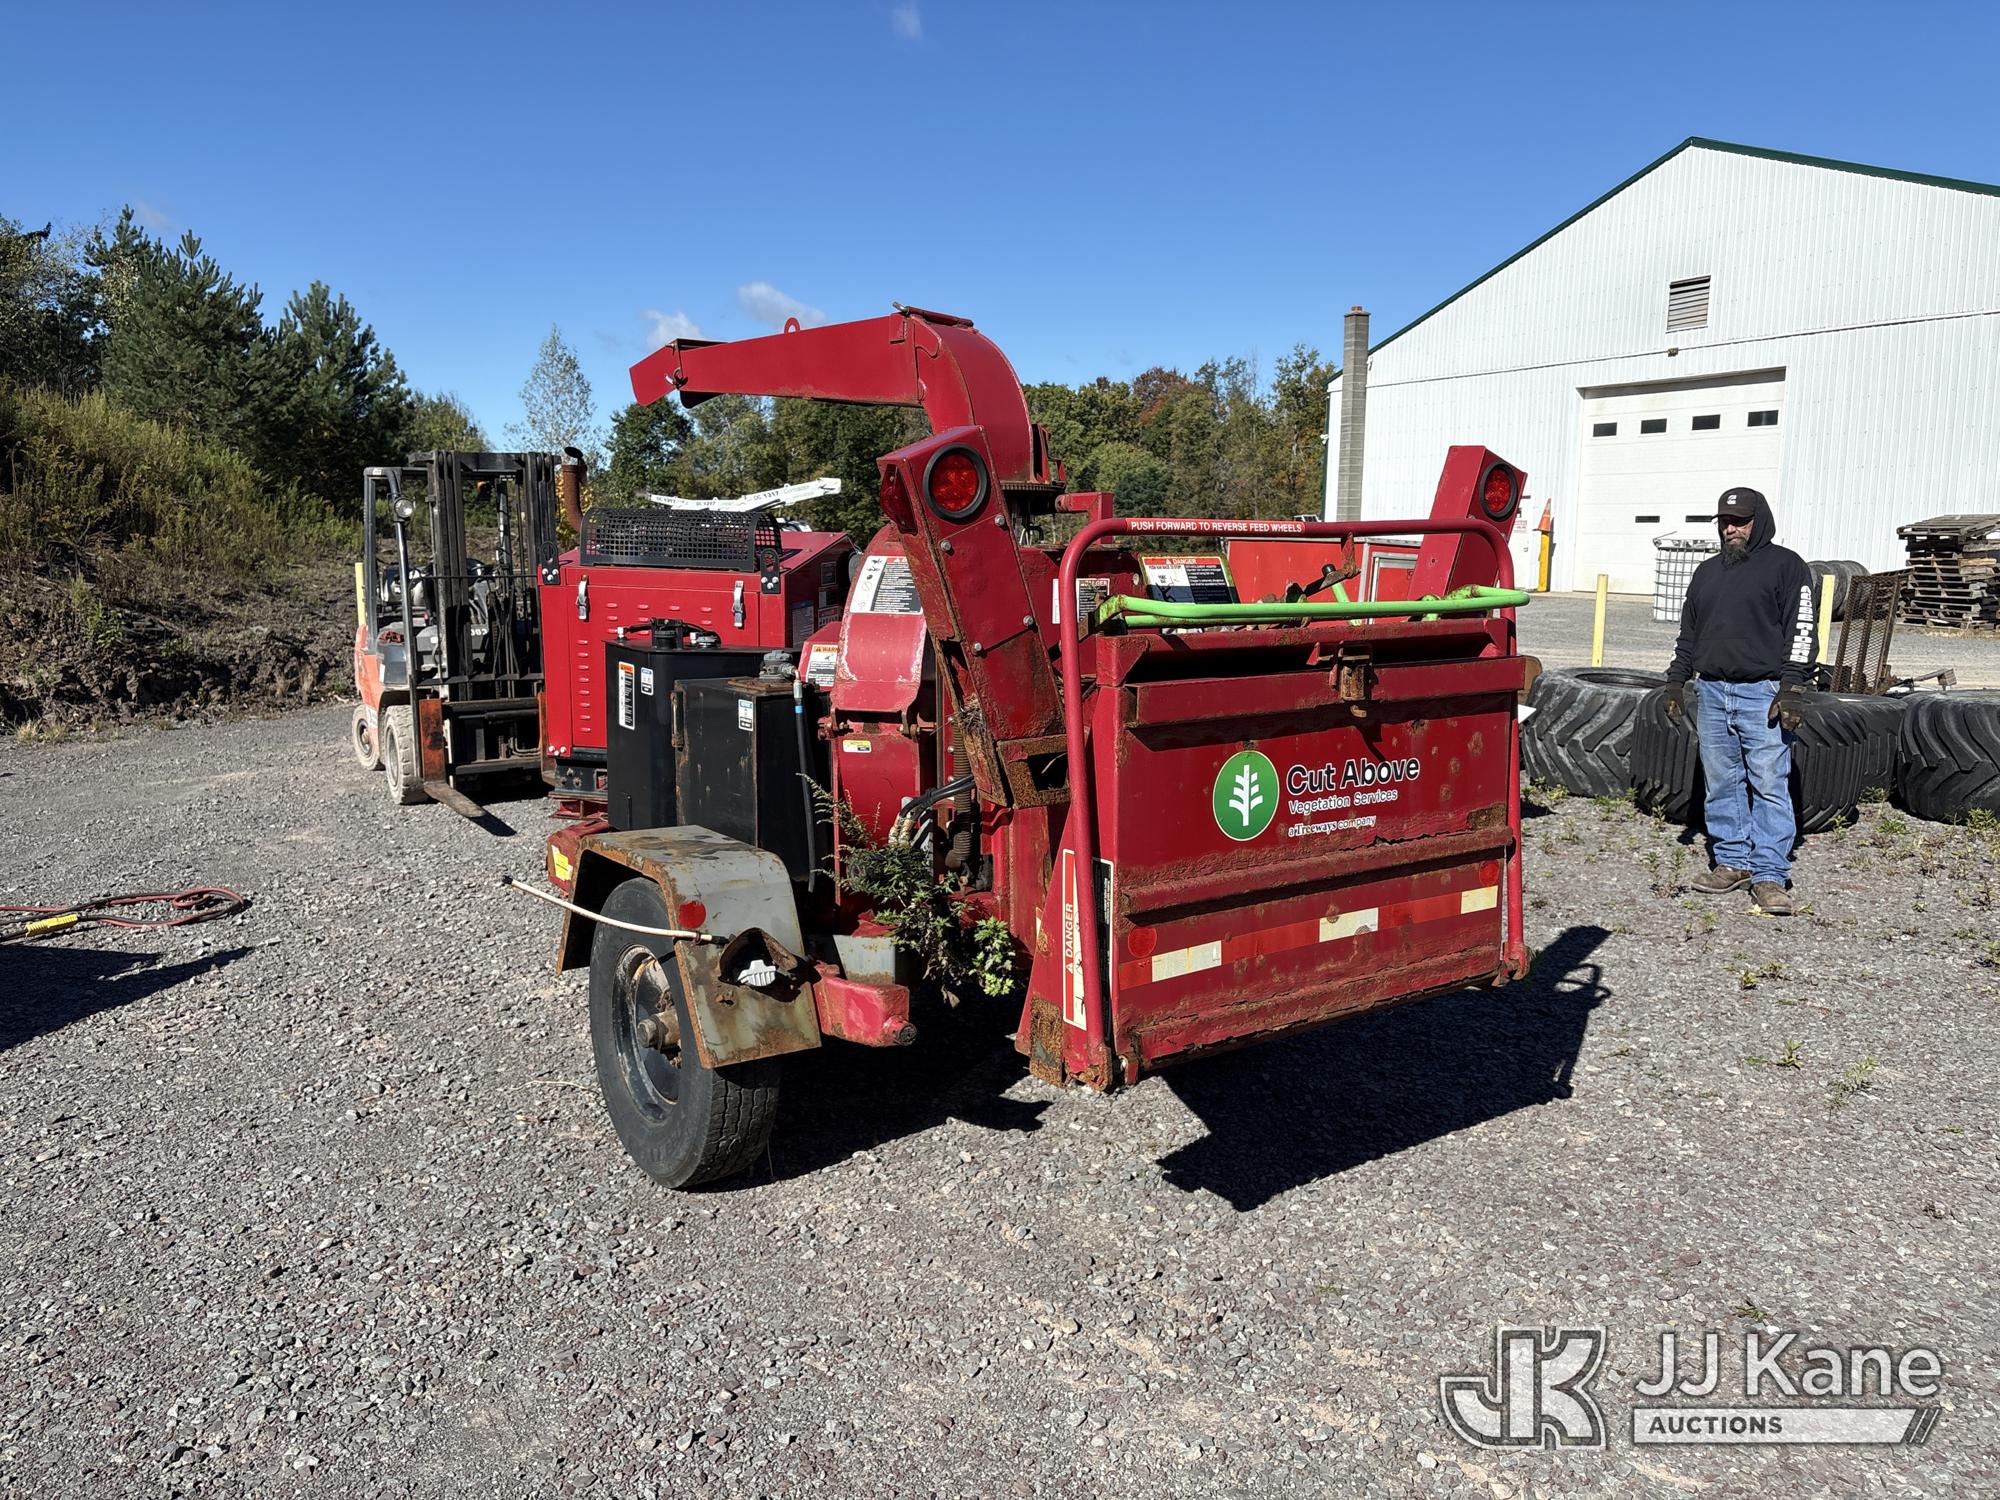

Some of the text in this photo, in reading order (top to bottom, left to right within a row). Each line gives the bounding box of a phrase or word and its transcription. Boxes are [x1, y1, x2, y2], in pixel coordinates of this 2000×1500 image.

[763, 490, 780, 499] 1317
[1131, 521, 1302, 533] PUSH FORWARD TO REVERSE FEED WHEELS
[1286, 757, 1420, 795] Cut Above
[1288, 789, 1398, 816] Vegetation Services
[1288, 827, 1295, 837] a
[1337, 815, 1377, 830] company
[1065, 903, 1073, 959] DANGER
